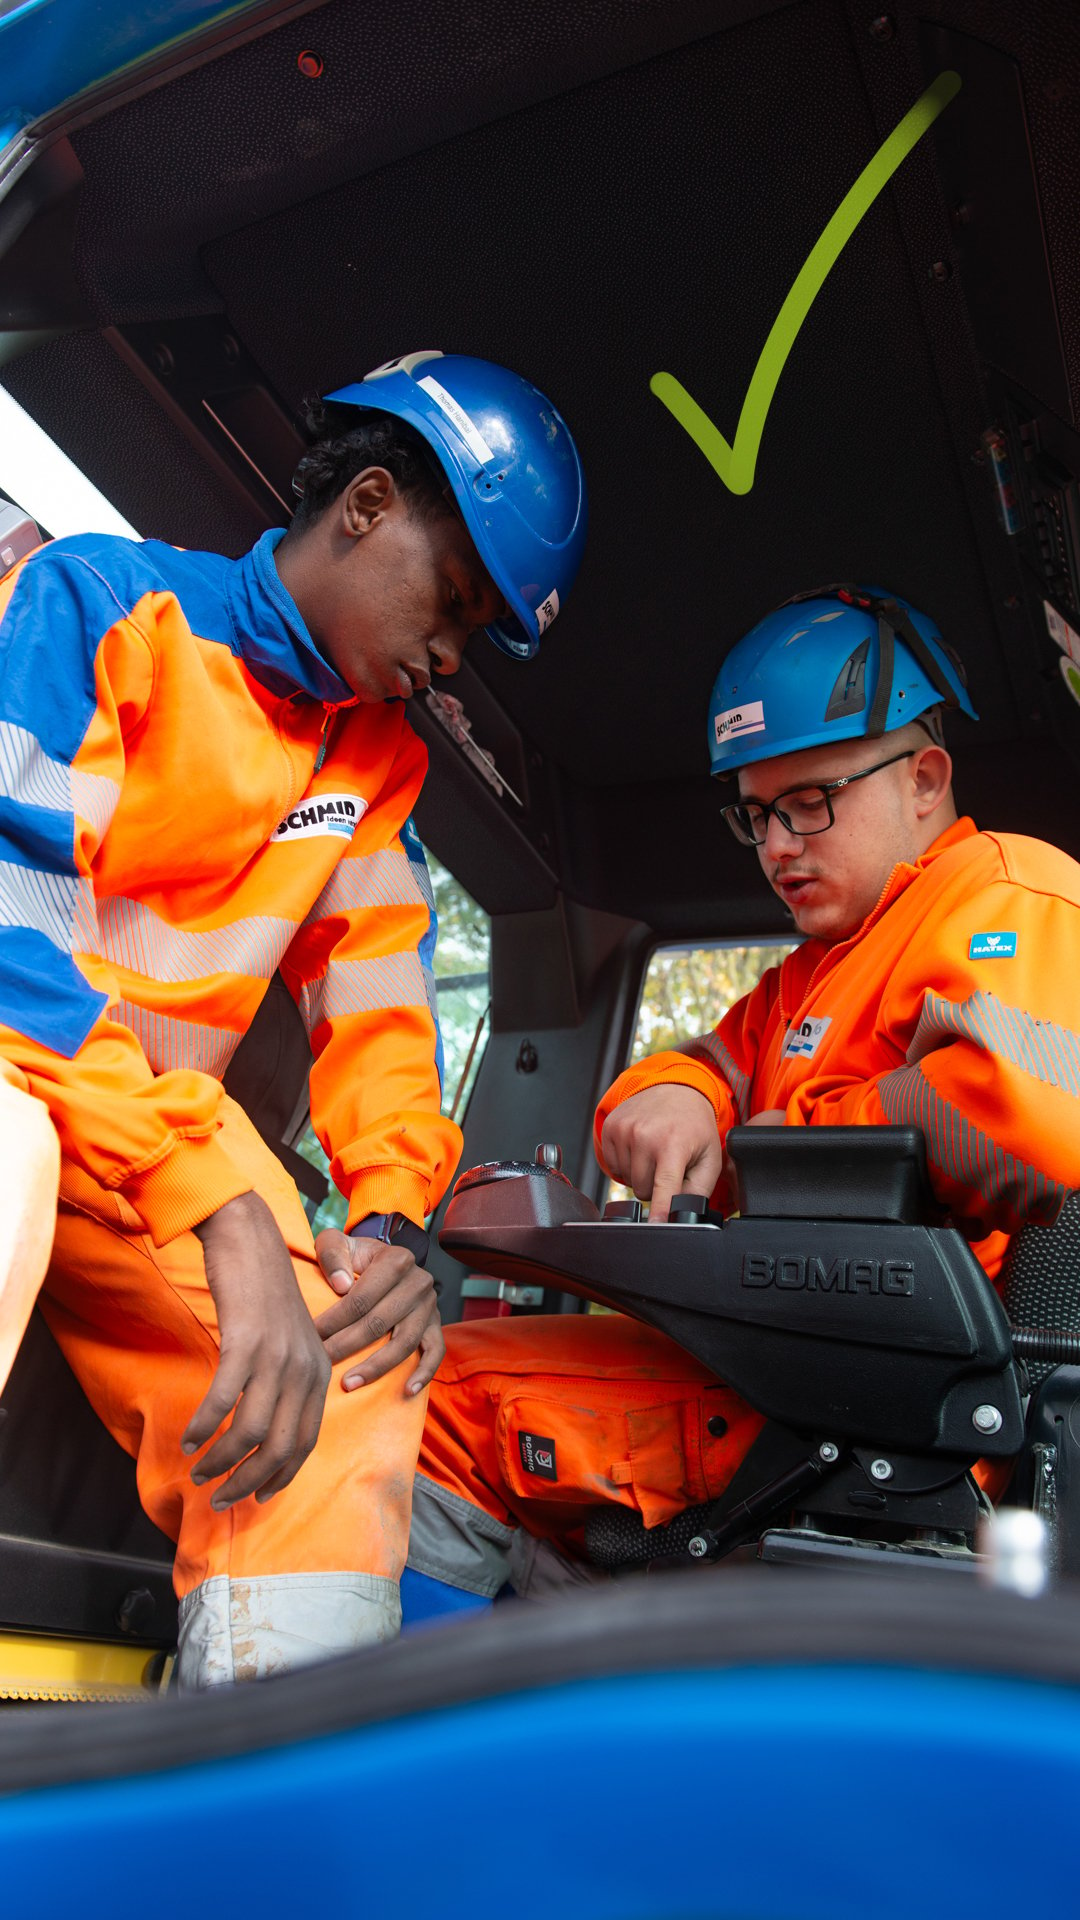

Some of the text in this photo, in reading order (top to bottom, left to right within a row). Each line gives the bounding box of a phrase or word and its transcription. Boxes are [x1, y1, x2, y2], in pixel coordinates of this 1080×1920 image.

[437, 393, 455, 413] Thomas
[277, 801, 355, 834] SCHMID
[742, 1252, 915, 1296] BOMAG
[525, 1435, 534, 1471] BORMIO
